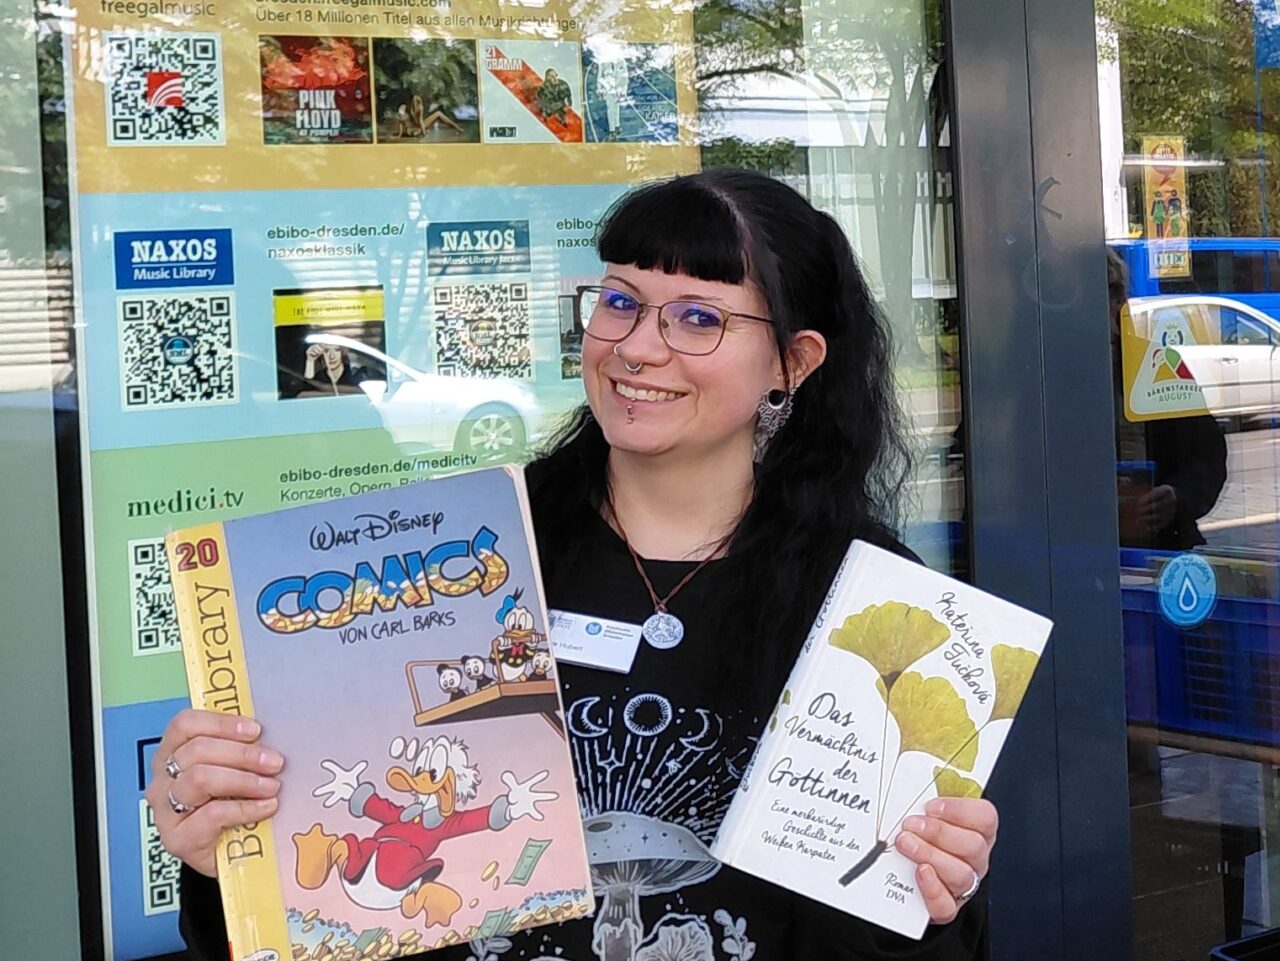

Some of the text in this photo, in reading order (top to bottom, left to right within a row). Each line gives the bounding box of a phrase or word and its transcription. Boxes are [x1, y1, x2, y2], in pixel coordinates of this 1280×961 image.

[296, 10, 413, 25] 18 Millionen Titel
[298, 89, 337, 109] PINK
[295, 110, 342, 129] FLOYD
[267, 223, 406, 241] ebibo-dresden.de/
[440, 229, 516, 252] NAXOS
[131, 238, 218, 263] NAXOS
[267, 242, 367, 259] naxosklassik
[133, 267, 217, 281] Music Library
[1158, 392, 1193, 403] AUGUST
[279, 453, 478, 485] ebibo-dresden.de/medicitv
[127, 488, 245, 518] medici.tv
[280, 485, 346, 503] Konzerte,
[175, 537, 220, 573] 20
[256, 525, 510, 635] COMICS
[338, 610, 457, 646] VON CARL BARKS
[807, 692, 856, 728] Das
[783, 715, 879, 763] Vermächtnis
[832, 760, 859, 784] der
[767, 757, 872, 814] Göttinnen
[770, 798, 847, 831] Eine merkwürdige
[782, 819, 828, 843] Geschichte
[760, 830, 837, 863] Weißen Karpaten
[884, 872, 916, 895] Roman
[885, 888, 907, 905] DVA
